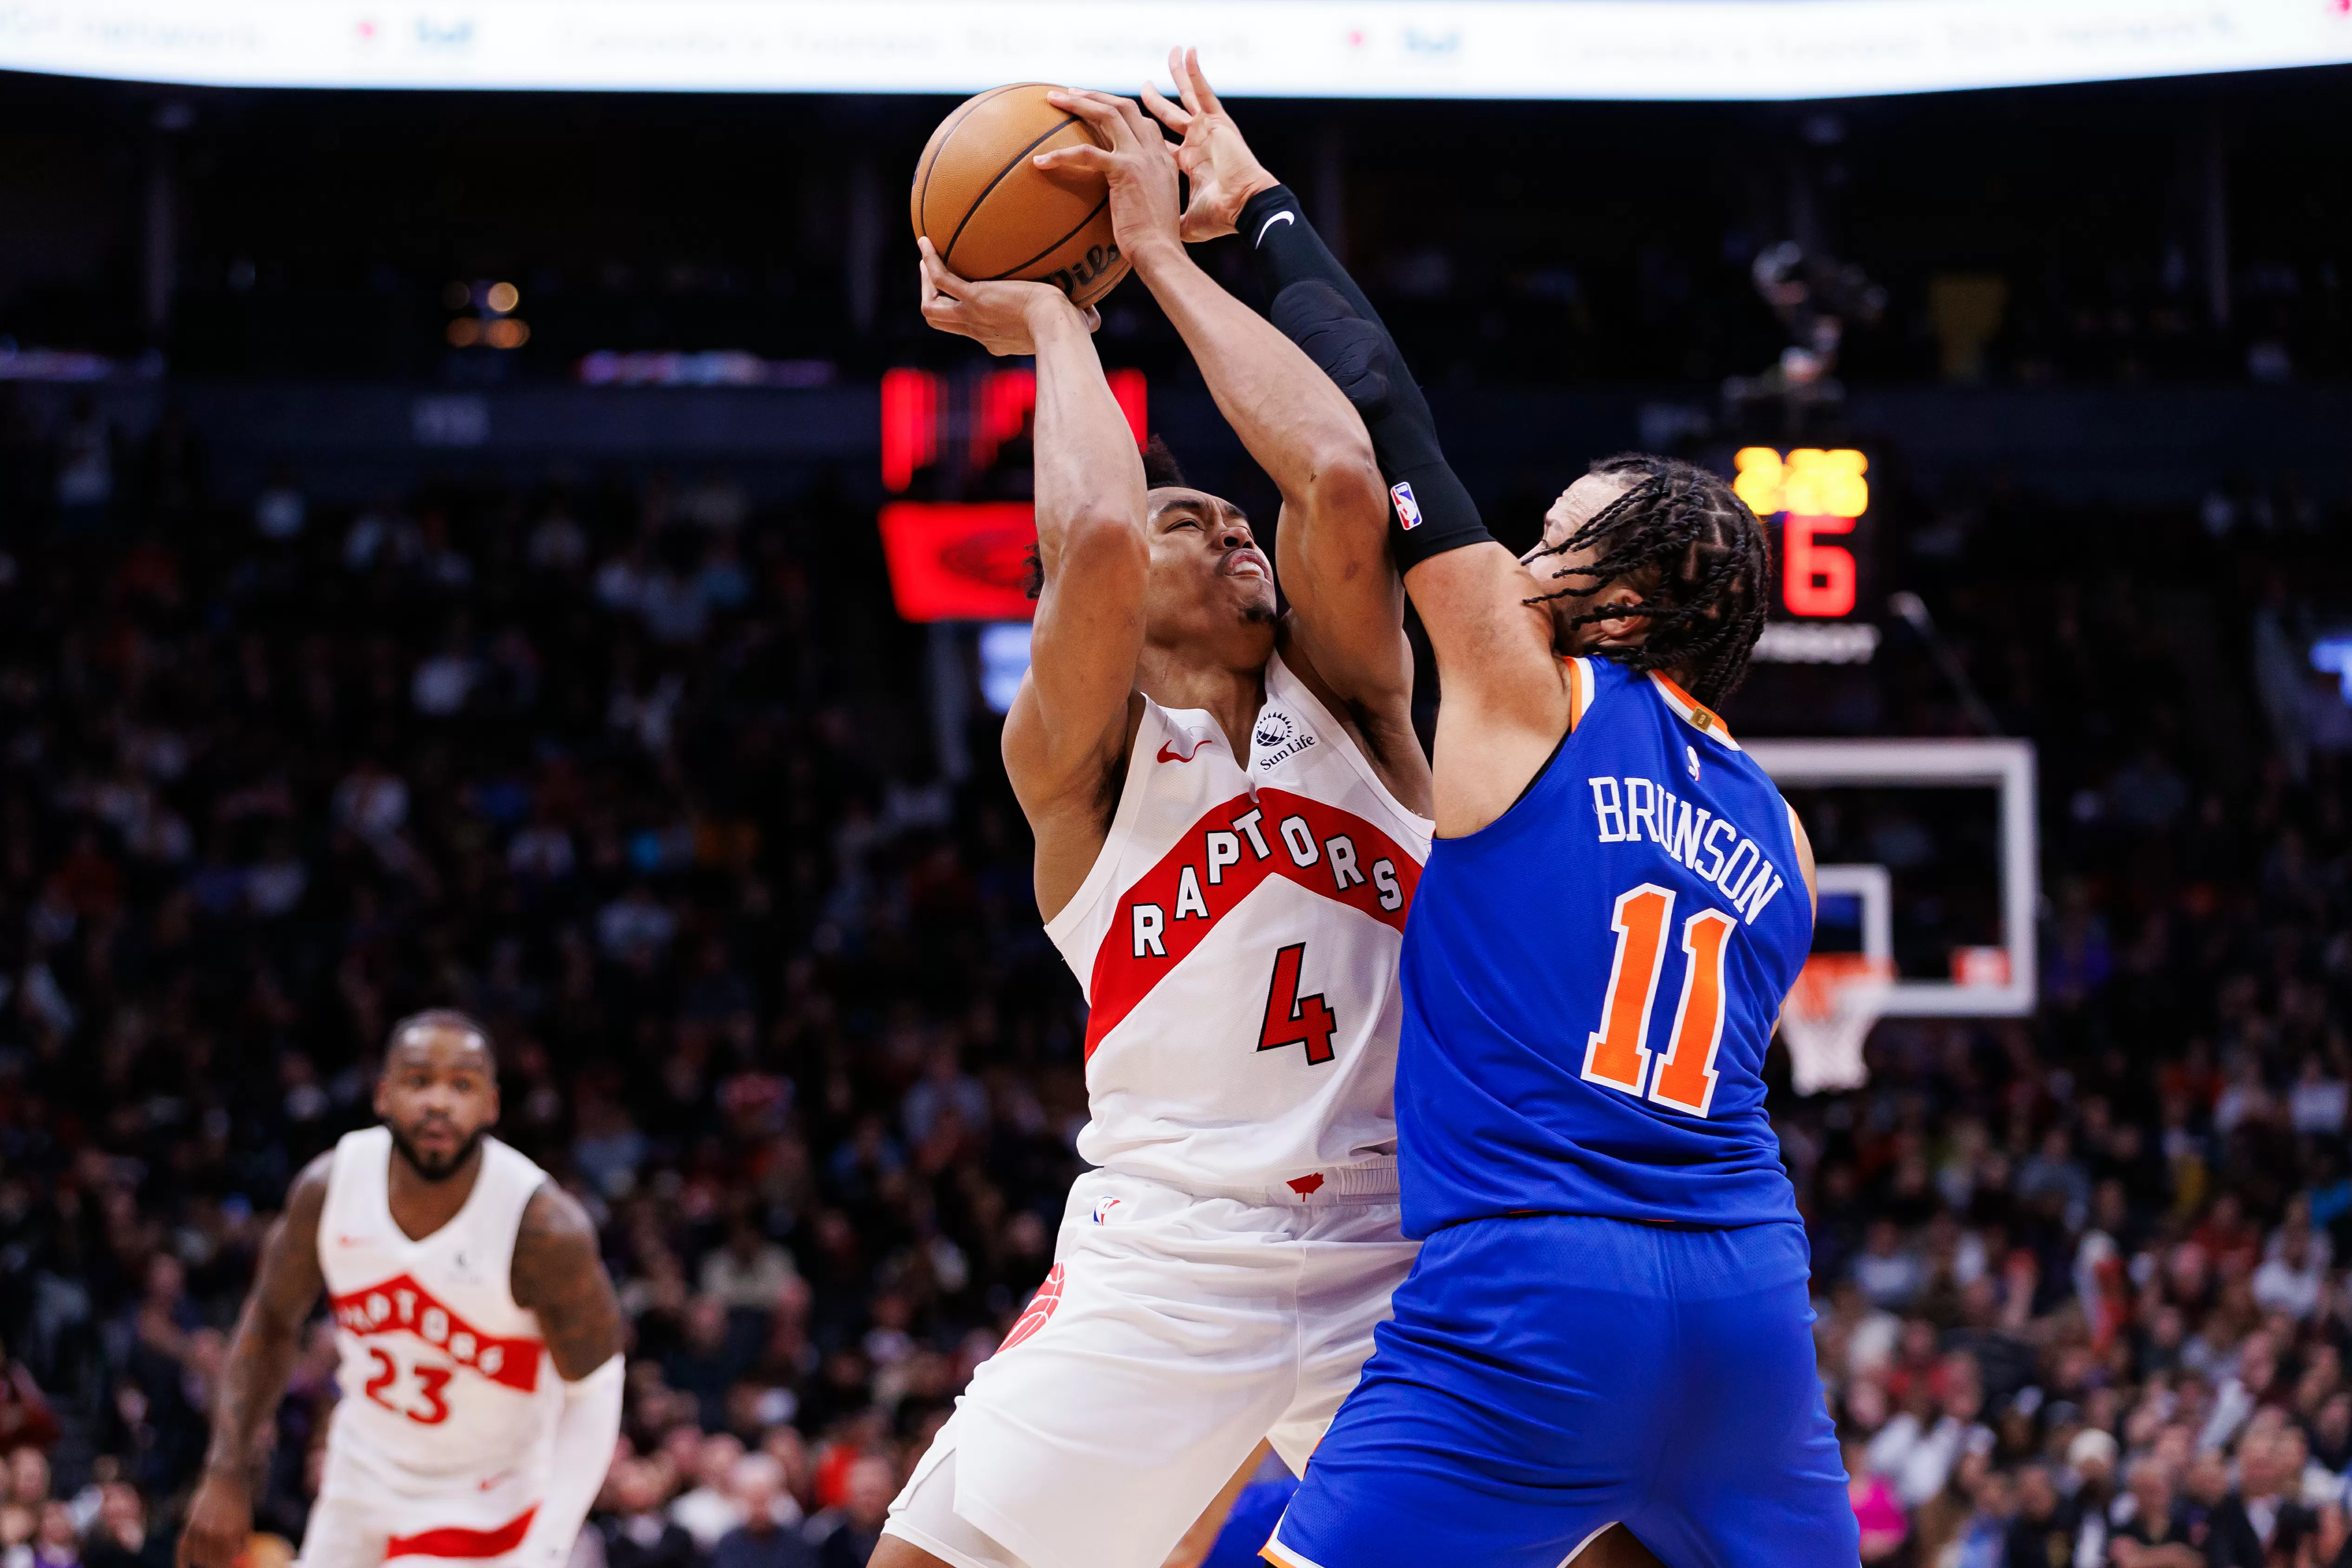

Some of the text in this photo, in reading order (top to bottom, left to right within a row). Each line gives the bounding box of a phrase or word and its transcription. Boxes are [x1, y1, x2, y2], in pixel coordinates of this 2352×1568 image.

[1044, 244, 1121, 296] ils
[1783, 510, 1856, 617] 6
[1260, 734, 1316, 771] Sun Life
[1131, 805, 1404, 959] RAPTORS
[1588, 776, 1784, 926] BRUNSON
[1257, 942, 1337, 1066] 4
[1581, 882, 1738, 1118] 11
[365, 1348, 453, 1425] 23
